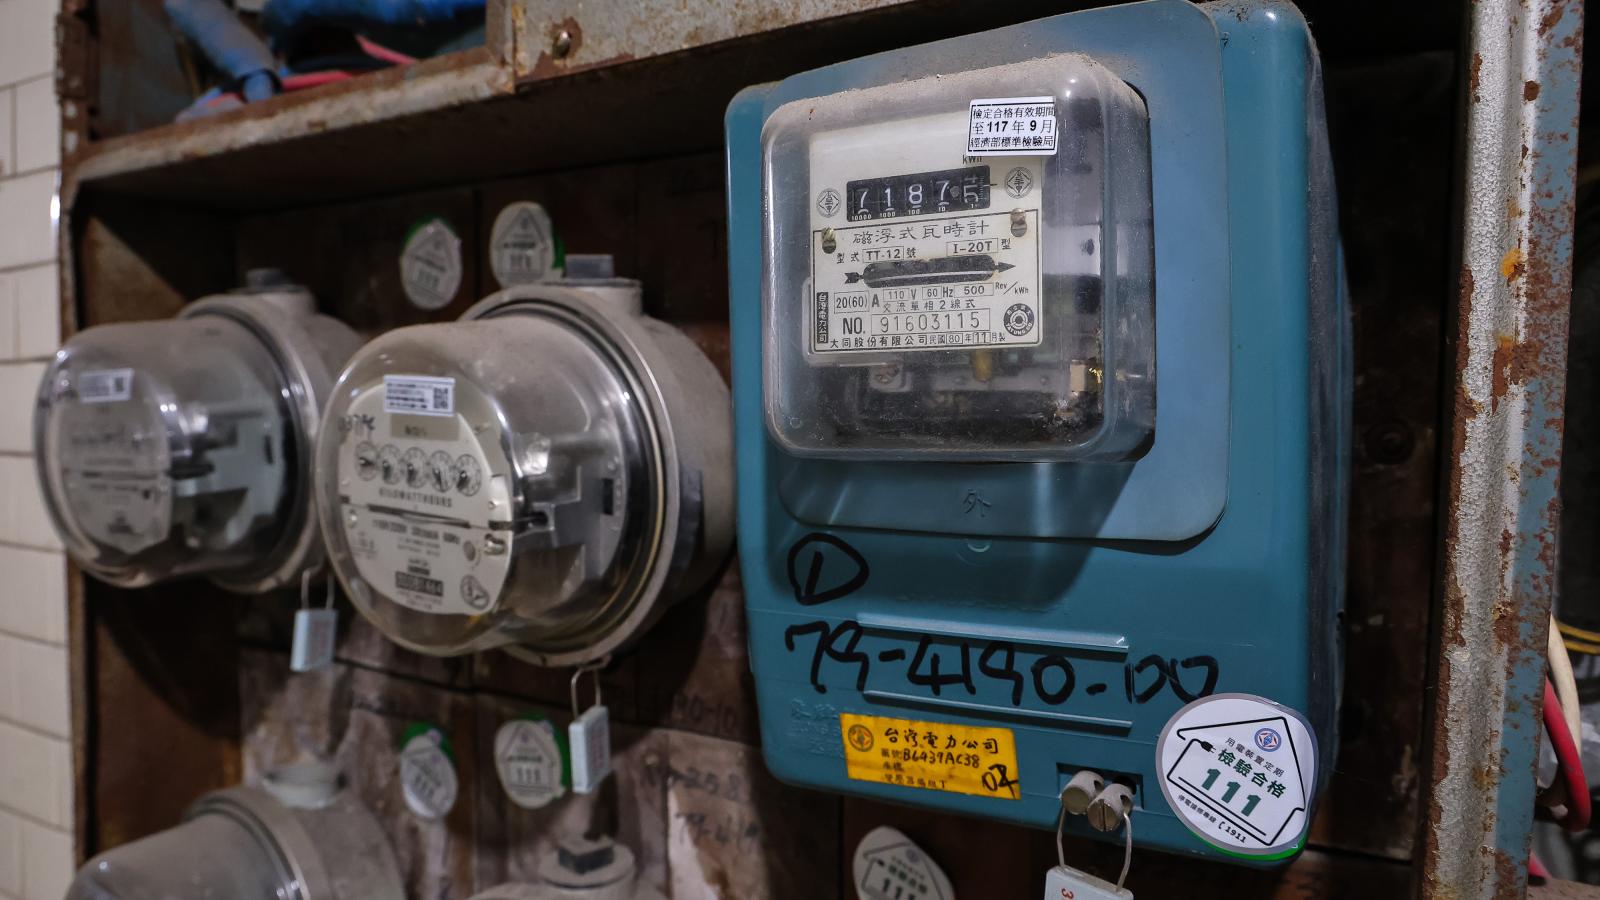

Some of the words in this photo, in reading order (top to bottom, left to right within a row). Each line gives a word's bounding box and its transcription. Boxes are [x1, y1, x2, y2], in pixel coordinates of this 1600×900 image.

[973, 106, 1054, 119] 檢定合格有效期間
[972, 121, 984, 135] 至
[987, 120, 1009, 133] 117
[1012, 119, 1025, 134] 年
[1029, 119, 1037, 132] 9
[1040, 119, 1053, 134] 月
[970, 135, 1054, 148] 經濟部標準檢驗局
[865, 248, 901, 260] TT-12
[953, 240, 992, 254] I-20T
[1000, 238, 1011, 250] 型
[836, 295, 868, 310] 20(60)
[872, 293, 880, 308] A
[888, 289, 904, 300] 110
[910, 289, 917, 300] V
[926, 288, 938, 298] 60
[942, 286, 954, 299] Hz
[963, 285, 985, 296] 500
[843, 317, 865, 335] NO.
[880, 311, 980, 333] 91603115
[830, 335, 928, 349] 大同股份有限公司
[1218, 748, 1286, 799] 檢驗合格
[1201, 768, 1262, 817] 111
[1224, 825, 1248, 843] 1911
